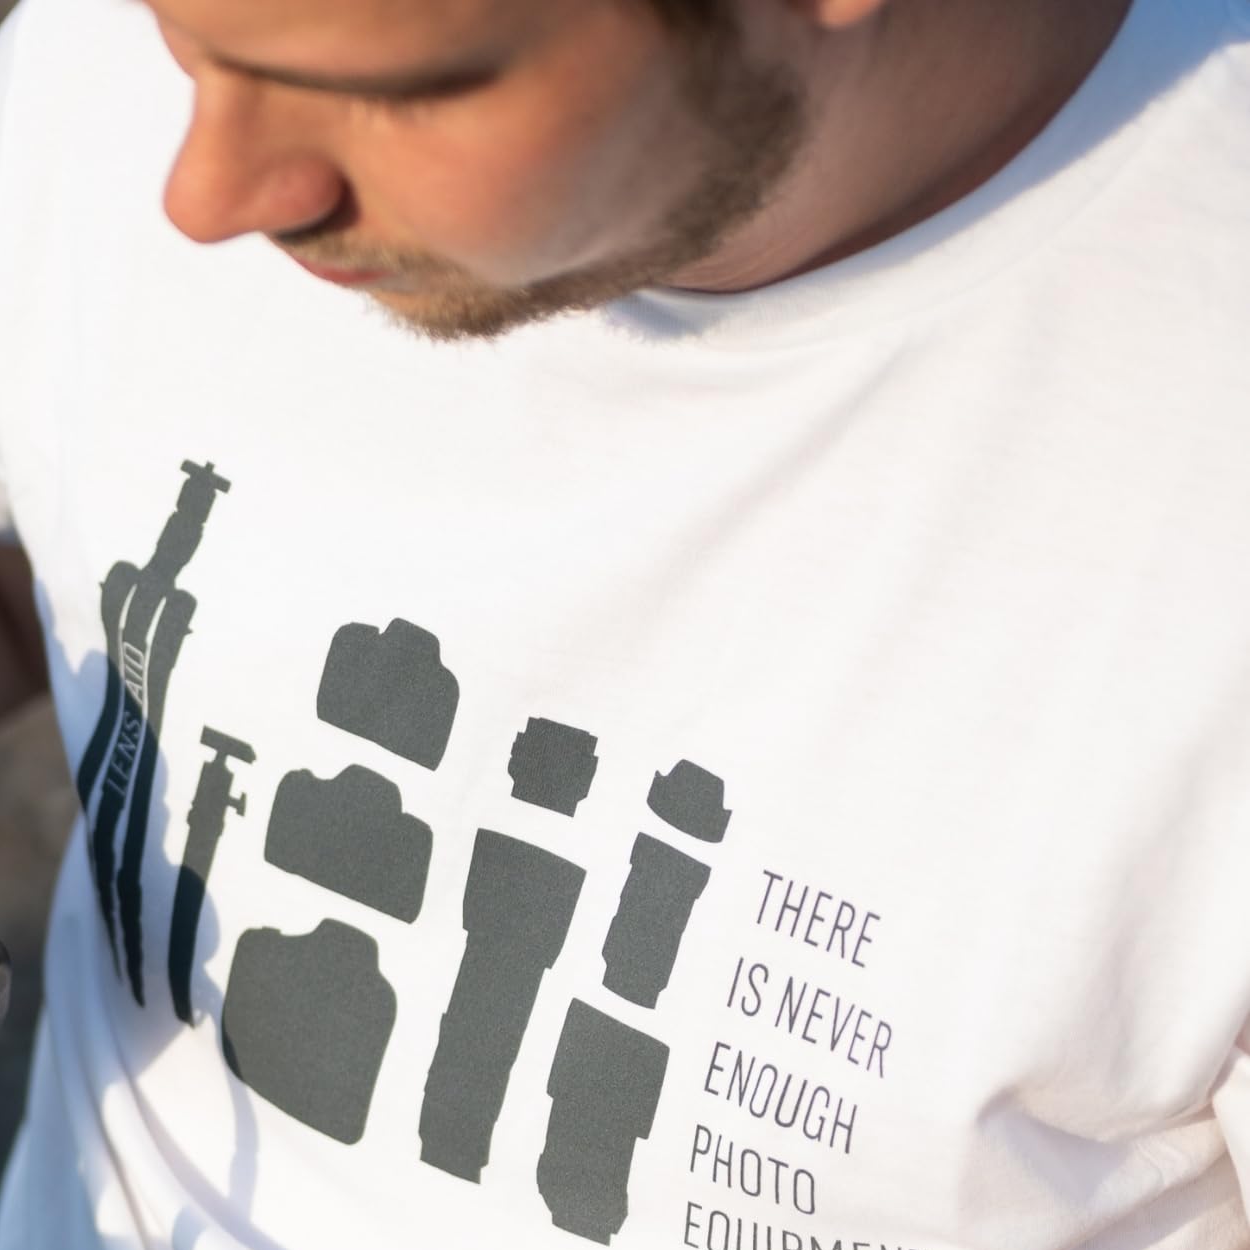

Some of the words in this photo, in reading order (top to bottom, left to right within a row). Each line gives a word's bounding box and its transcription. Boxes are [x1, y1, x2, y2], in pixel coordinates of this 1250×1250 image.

[122, 640, 146, 708] AID
[756, 869, 881, 968] THERE
[726, 956, 769, 1017] IS
[774, 975, 893, 1079] NEVER
[703, 1040, 858, 1155] ENOUGH
[689, 1124, 816, 1215] PHOTO
